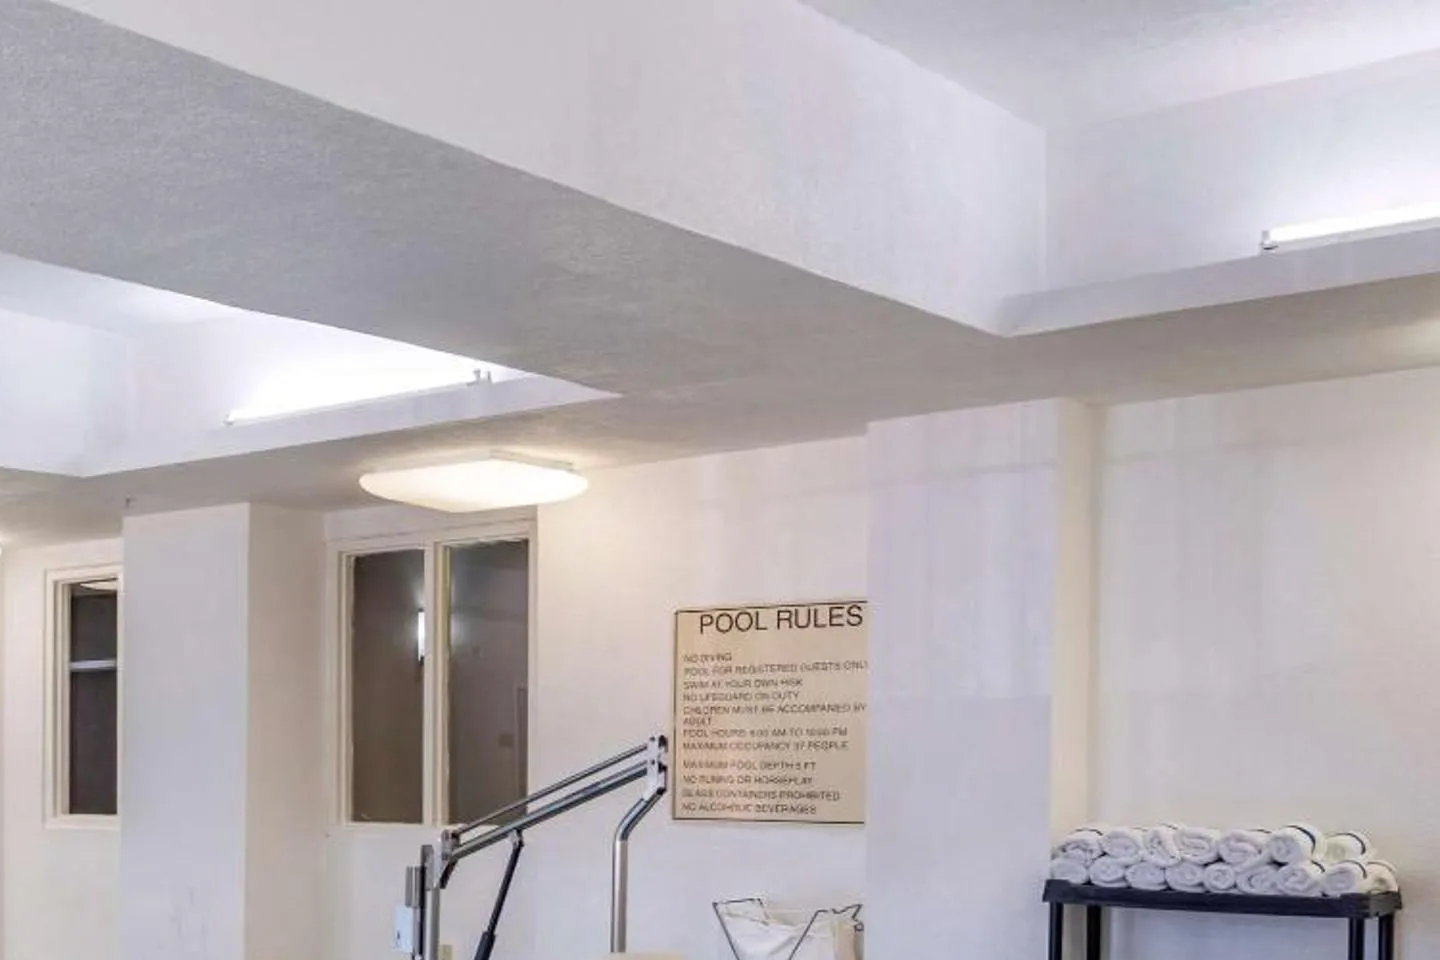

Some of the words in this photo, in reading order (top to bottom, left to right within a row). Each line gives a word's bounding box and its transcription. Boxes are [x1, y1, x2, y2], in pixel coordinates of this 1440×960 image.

[699, 611, 768, 635] POOL
[776, 604, 864, 630] RULES
[683, 653, 697, 663] NO
[699, 652, 732, 663] DIVING
[711, 665, 733, 676] FOR
[734, 663, 798, 675] REGISTERED
[800, 660, 842, 673] GUESTS
[683, 680, 709, 690] SWIM
[711, 680, 722, 690] AT
[725, 679, 752, 689] YOUR
[754, 679, 779, 688] OWN
[780, 678, 803, 687] RISK
[682, 693, 697, 702] NO
[754, 691, 770, 701] ON
[772, 690, 800, 701] DUTY
[683, 705, 730, 716] CHILDREN
[731, 704, 759, 715] MUST
[761, 704, 775, 714] BE
[777, 702, 851, 714] ACCOMPANIED
[683, 717, 712, 726] ADULT
[682, 727, 709, 738] POOL
[771, 727, 787, 737] AM
[789, 726, 803, 737] TO
[832, 726, 848, 737] PM
[682, 741, 728, 751] MAXIMUM
[729, 741, 790, 751] OCCUPANCY
[807, 740, 849, 751] PEOPLE
[682, 760, 728, 769] MAXIMUM
[730, 760, 758, 770] POOL
[760, 760, 794, 770] DEPTH
[803, 761, 816, 771] FT
[682, 774, 697, 784] NO
[736, 775, 752, 785] OR
[715, 789, 778, 800] CONTAINERS
[779, 790, 841, 802] PROHIBITED
[681, 802, 696, 812] NO
[698, 802, 753, 813] ALCOHOLIC
[755, 803, 817, 815] BEVERAGES
